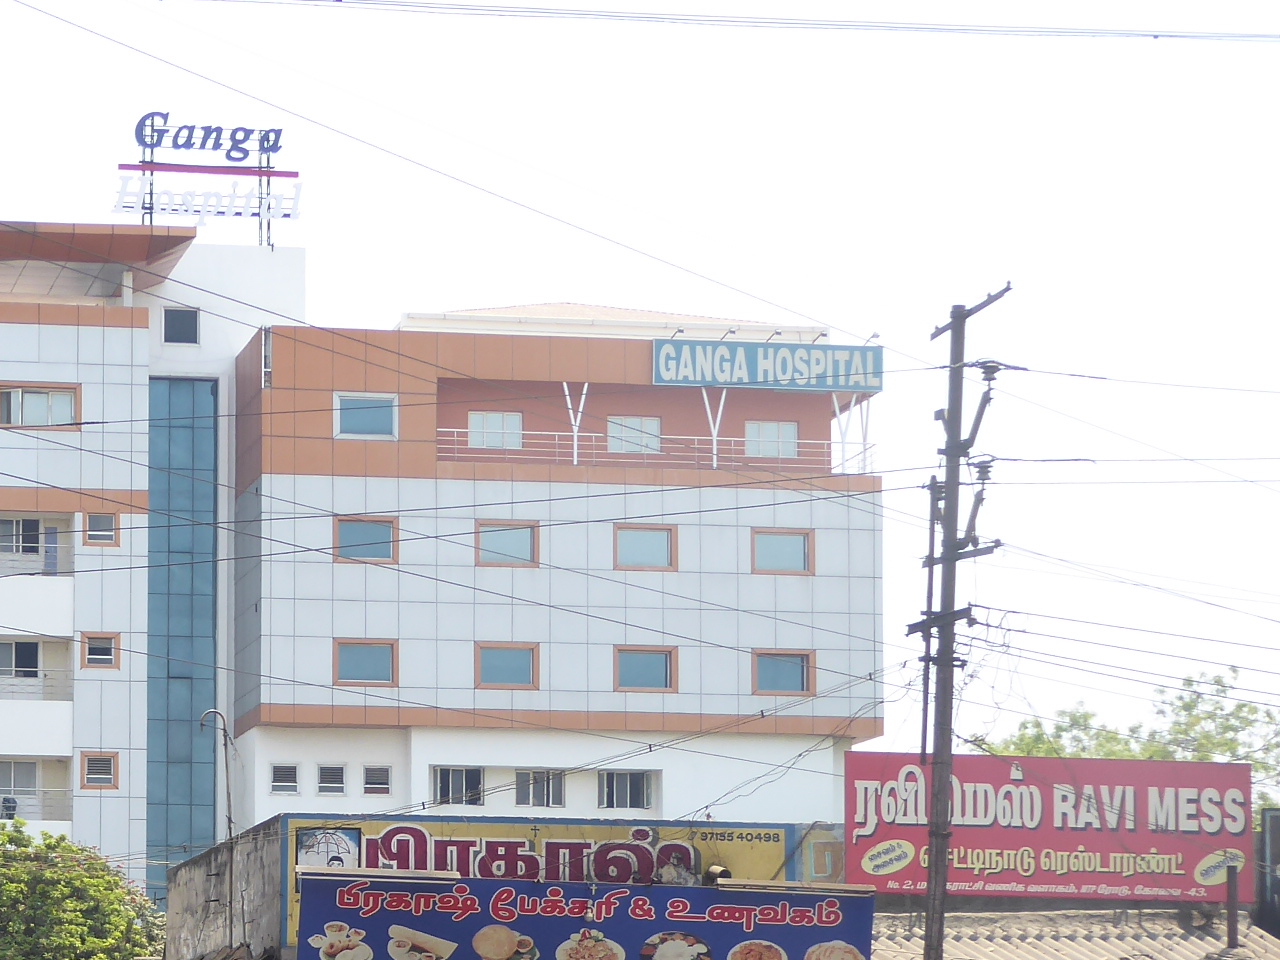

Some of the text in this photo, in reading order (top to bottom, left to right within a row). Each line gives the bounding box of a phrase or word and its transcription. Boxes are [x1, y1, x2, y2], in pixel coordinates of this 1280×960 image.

[135, 111, 282, 162] Ganga
[112, 176, 303, 226] Hospital
[659, 344, 880, 386] GANGA HOSPITAL
[853, 764, 927, 844] ரவி
[1053, 784, 1135, 829] RAVI
[1147, 787, 1245, 833] MESS
[736, 832, 780, 843] 40498
[337, 881, 842, 932] பிரகாஷ் பேக்கரி & உணவகம்
[887, 880, 899, 889] No.
